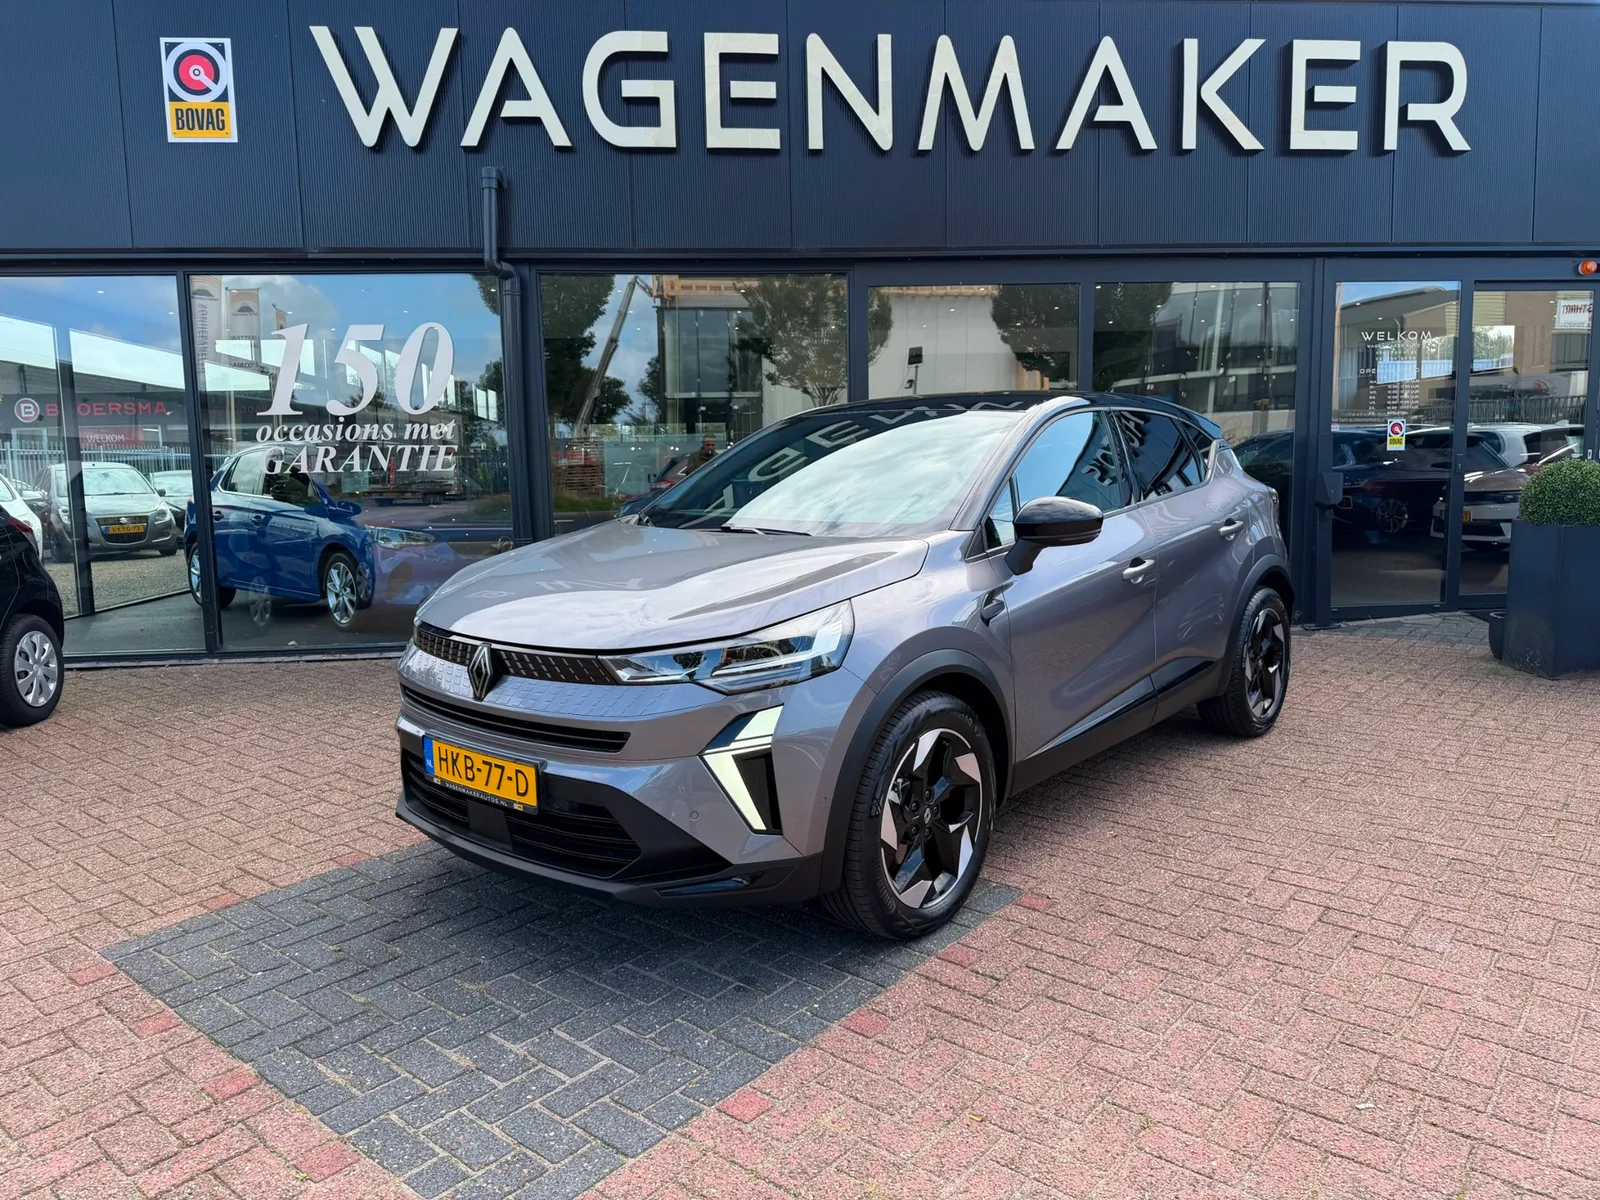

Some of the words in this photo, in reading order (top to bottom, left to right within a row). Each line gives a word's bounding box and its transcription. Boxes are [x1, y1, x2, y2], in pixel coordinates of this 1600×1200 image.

[309, 26, 1472, 152] WAGENMAKER
[174, 107, 226, 133] BOVAG
[1361, 330, 1433, 341] WELKOM
[256, 322, 454, 416] 150
[46, 401, 168, 417] BOERSMA
[86, 433, 125, 443] WELKOM
[256, 416, 394, 443] occasions
[404, 418, 456, 440] met
[260, 444, 459, 474] GARANTIE
[426, 758, 434, 768] NL
[438, 746, 529, 797] HKB-77-D
